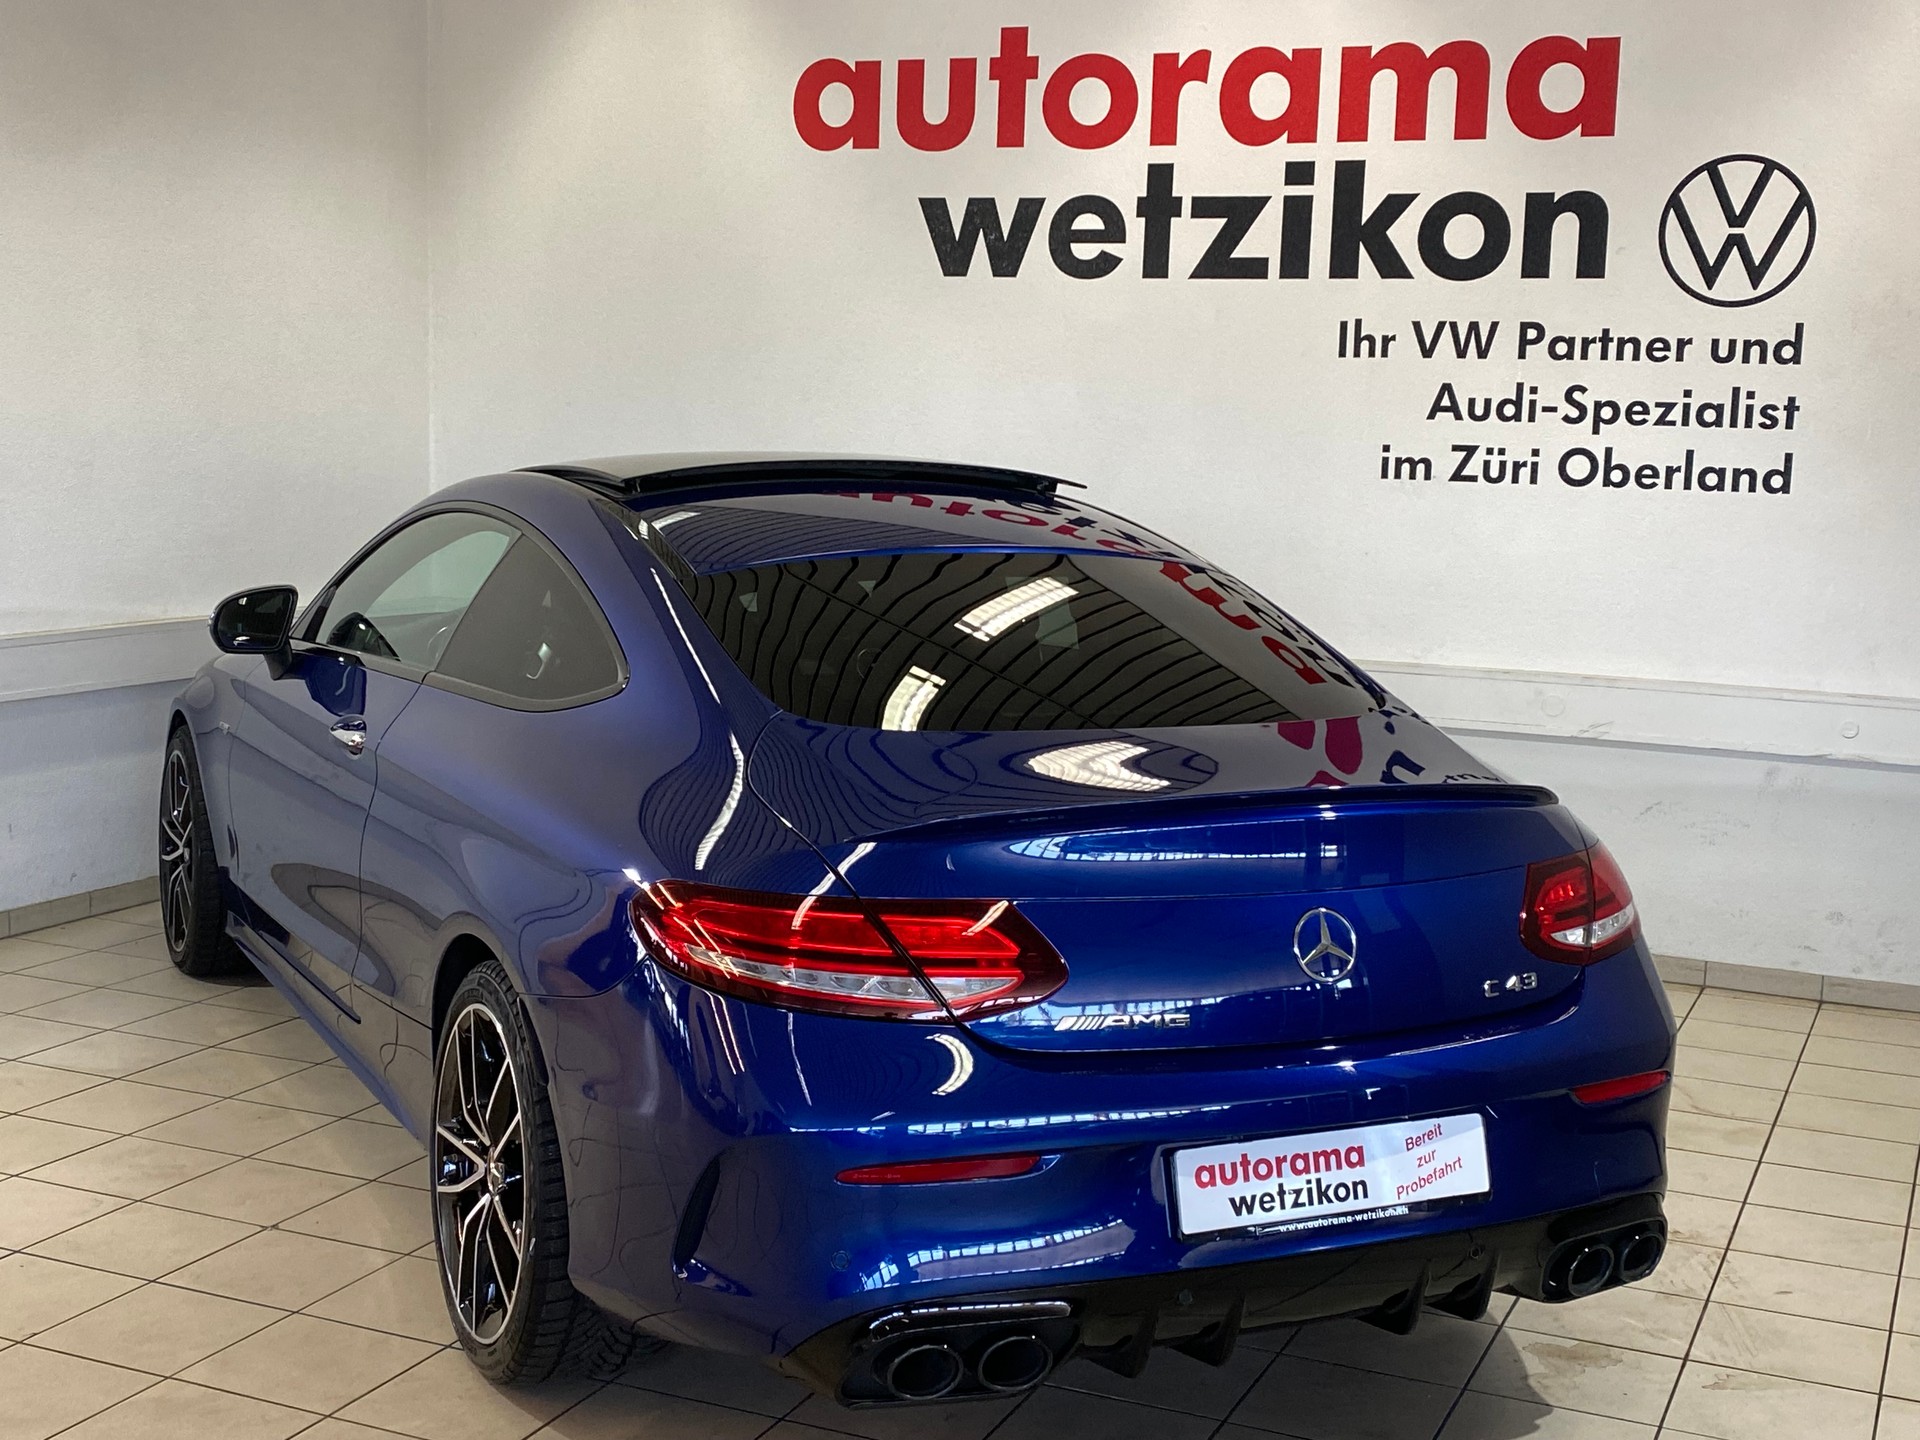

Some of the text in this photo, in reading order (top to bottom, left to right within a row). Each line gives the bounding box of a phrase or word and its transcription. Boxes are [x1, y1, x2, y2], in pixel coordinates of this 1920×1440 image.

[793, 27, 1620, 151] autorama
[919, 160, 1609, 281] wetzikon
[1339, 319, 1804, 365] Ihr VW Partner und
[1427, 382, 1801, 435] Audi-Spezialist
[1381, 445, 1793, 494] im Züri Oberland
[1405, 1123, 1442, 1152] Bereit
[1416, 1149, 1437, 1168] zur
[1194, 1145, 1366, 1189] autorama
[1396, 1156, 1463, 1200] Probefahrt
[1228, 1178, 1369, 1217] wetzikon
